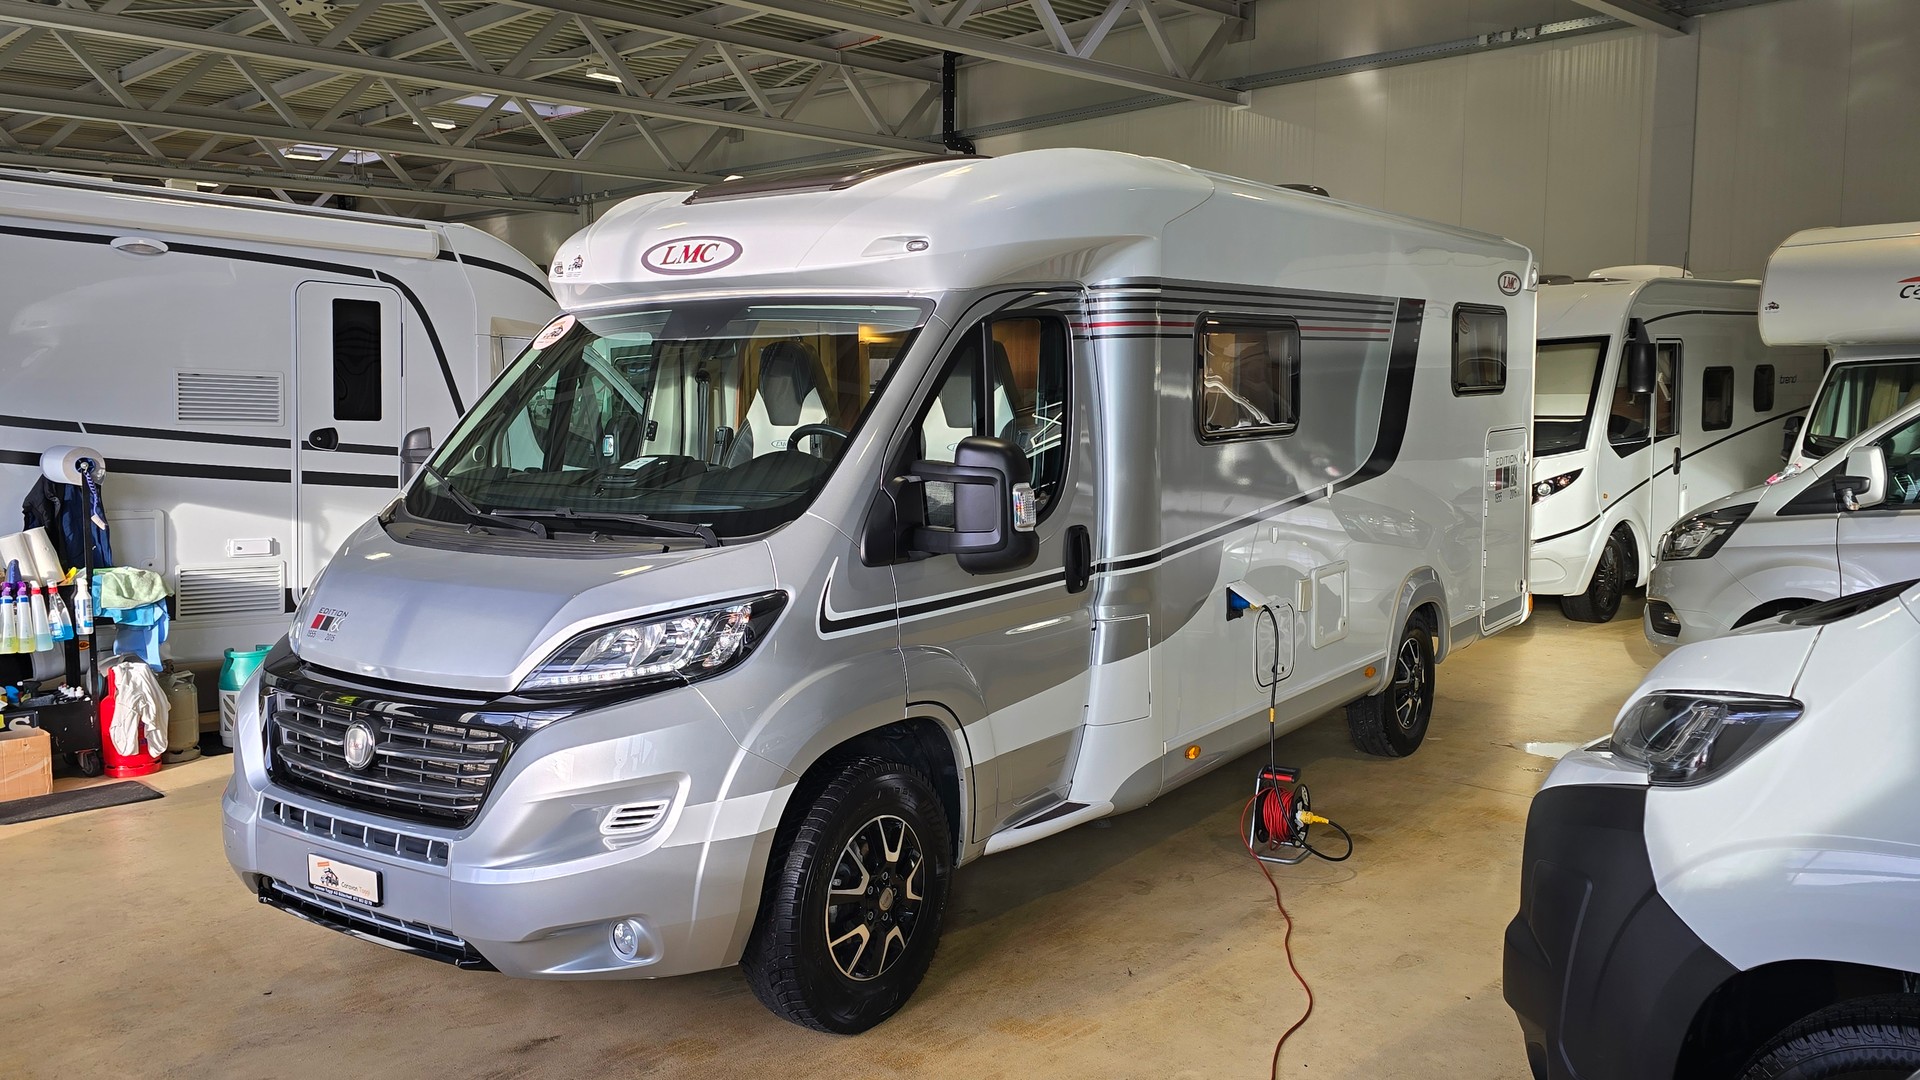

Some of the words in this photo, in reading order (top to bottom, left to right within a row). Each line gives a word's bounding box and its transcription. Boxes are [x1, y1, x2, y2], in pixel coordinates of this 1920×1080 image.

[659, 243, 721, 266] LMC
[1503, 275, 1518, 290] LMC
[1496, 454, 1519, 467] EDITION
[318, 606, 350, 618] EDITION
